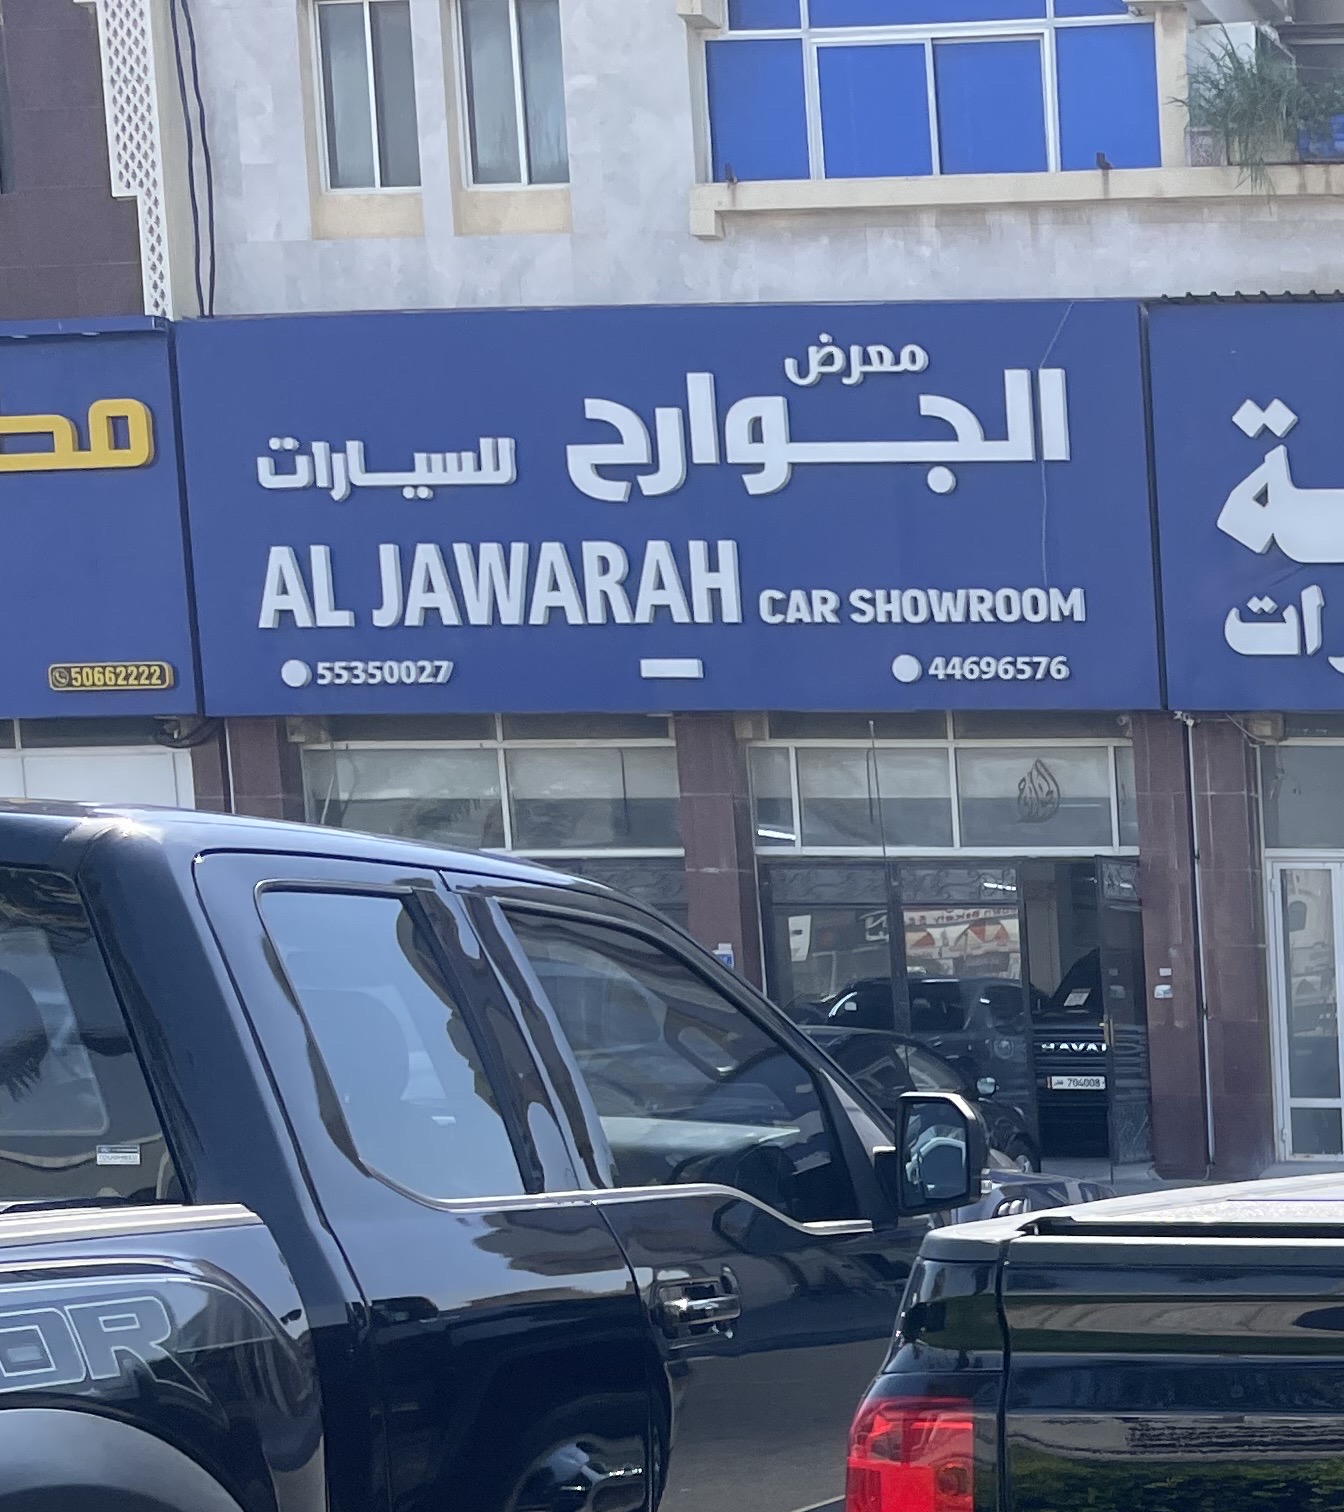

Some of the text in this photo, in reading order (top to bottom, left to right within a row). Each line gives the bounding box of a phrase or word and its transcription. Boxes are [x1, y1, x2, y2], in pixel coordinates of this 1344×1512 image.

[785, 333, 929, 386] معرض
[566, 367, 1071, 503] الجوارح
[257, 437, 517, 501] للسيارات
[258, 540, 1087, 629] AL JAWARAH CAR SHOWROOM
[70, 665, 162, 687] 50662222
[316, 659, 455, 686] 55350027
[928, 655, 1071, 682] 44696576
